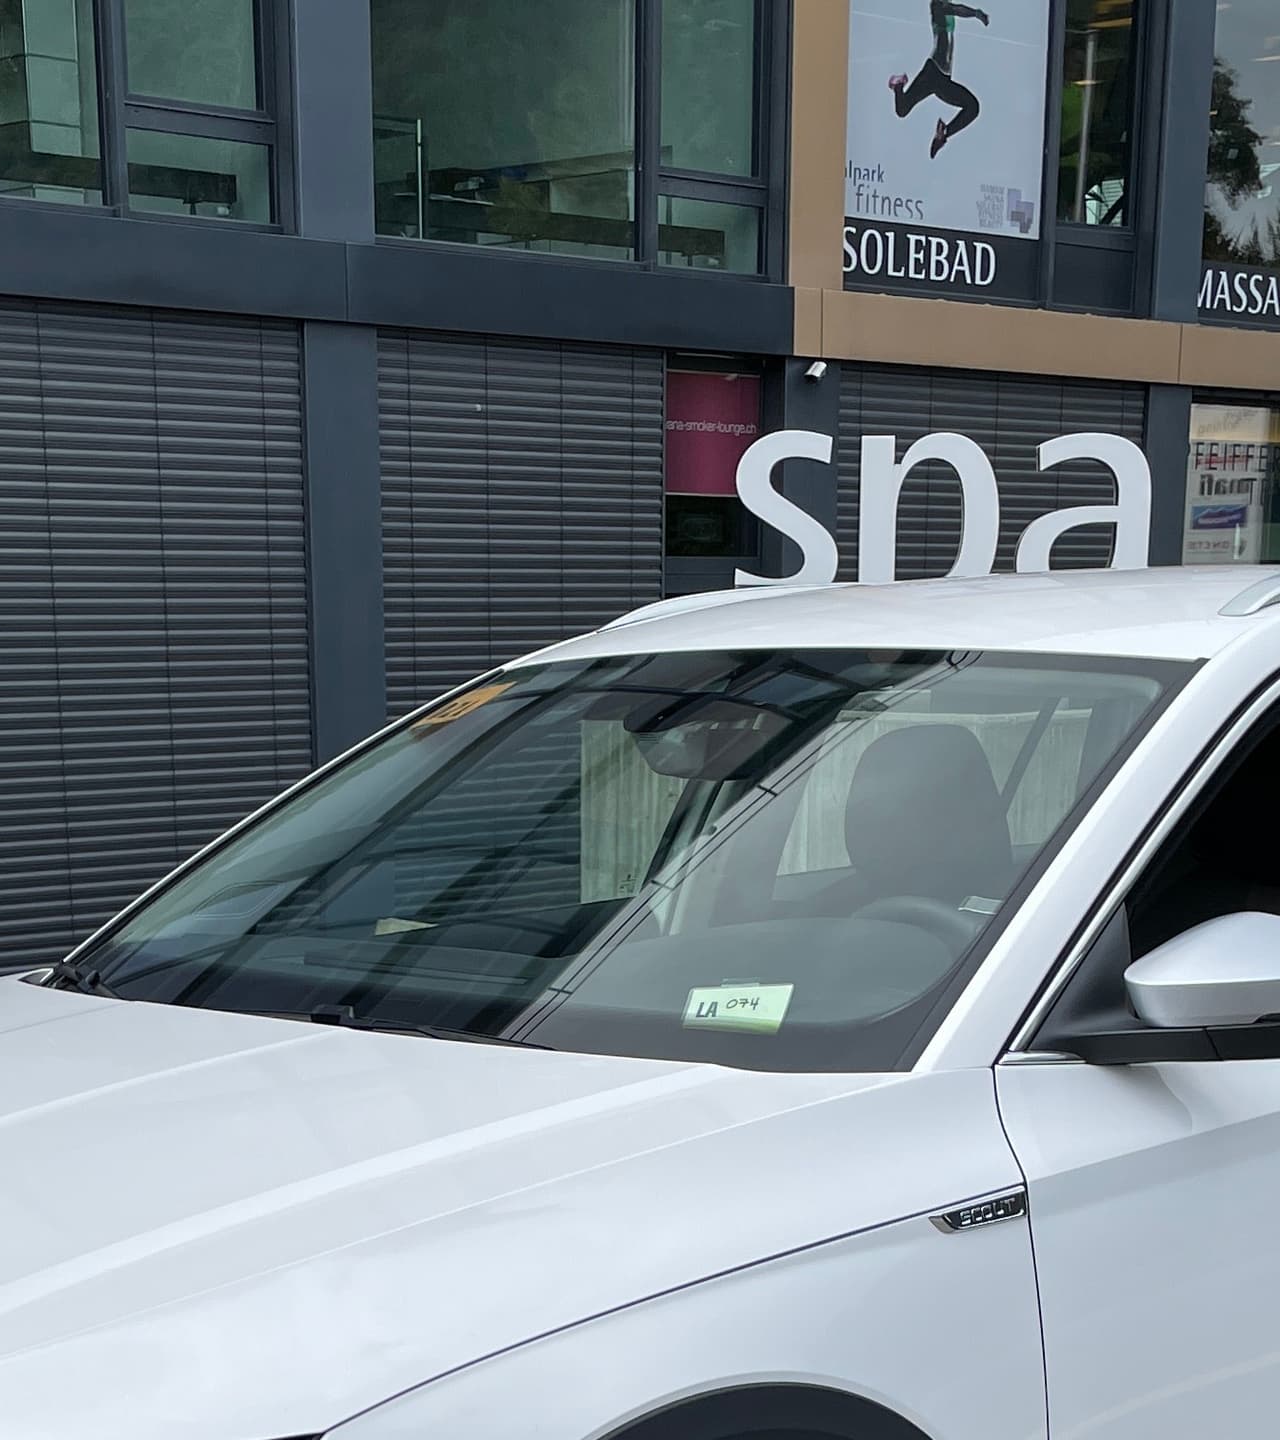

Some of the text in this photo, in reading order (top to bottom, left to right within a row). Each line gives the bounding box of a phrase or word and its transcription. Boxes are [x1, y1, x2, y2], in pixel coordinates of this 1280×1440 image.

[856, 184, 924, 220] fitness
[843, 226, 996, 286] SOLEBAD
[695, 1001, 719, 1018] LA
[960, 1197, 1015, 1225] SCOUT
